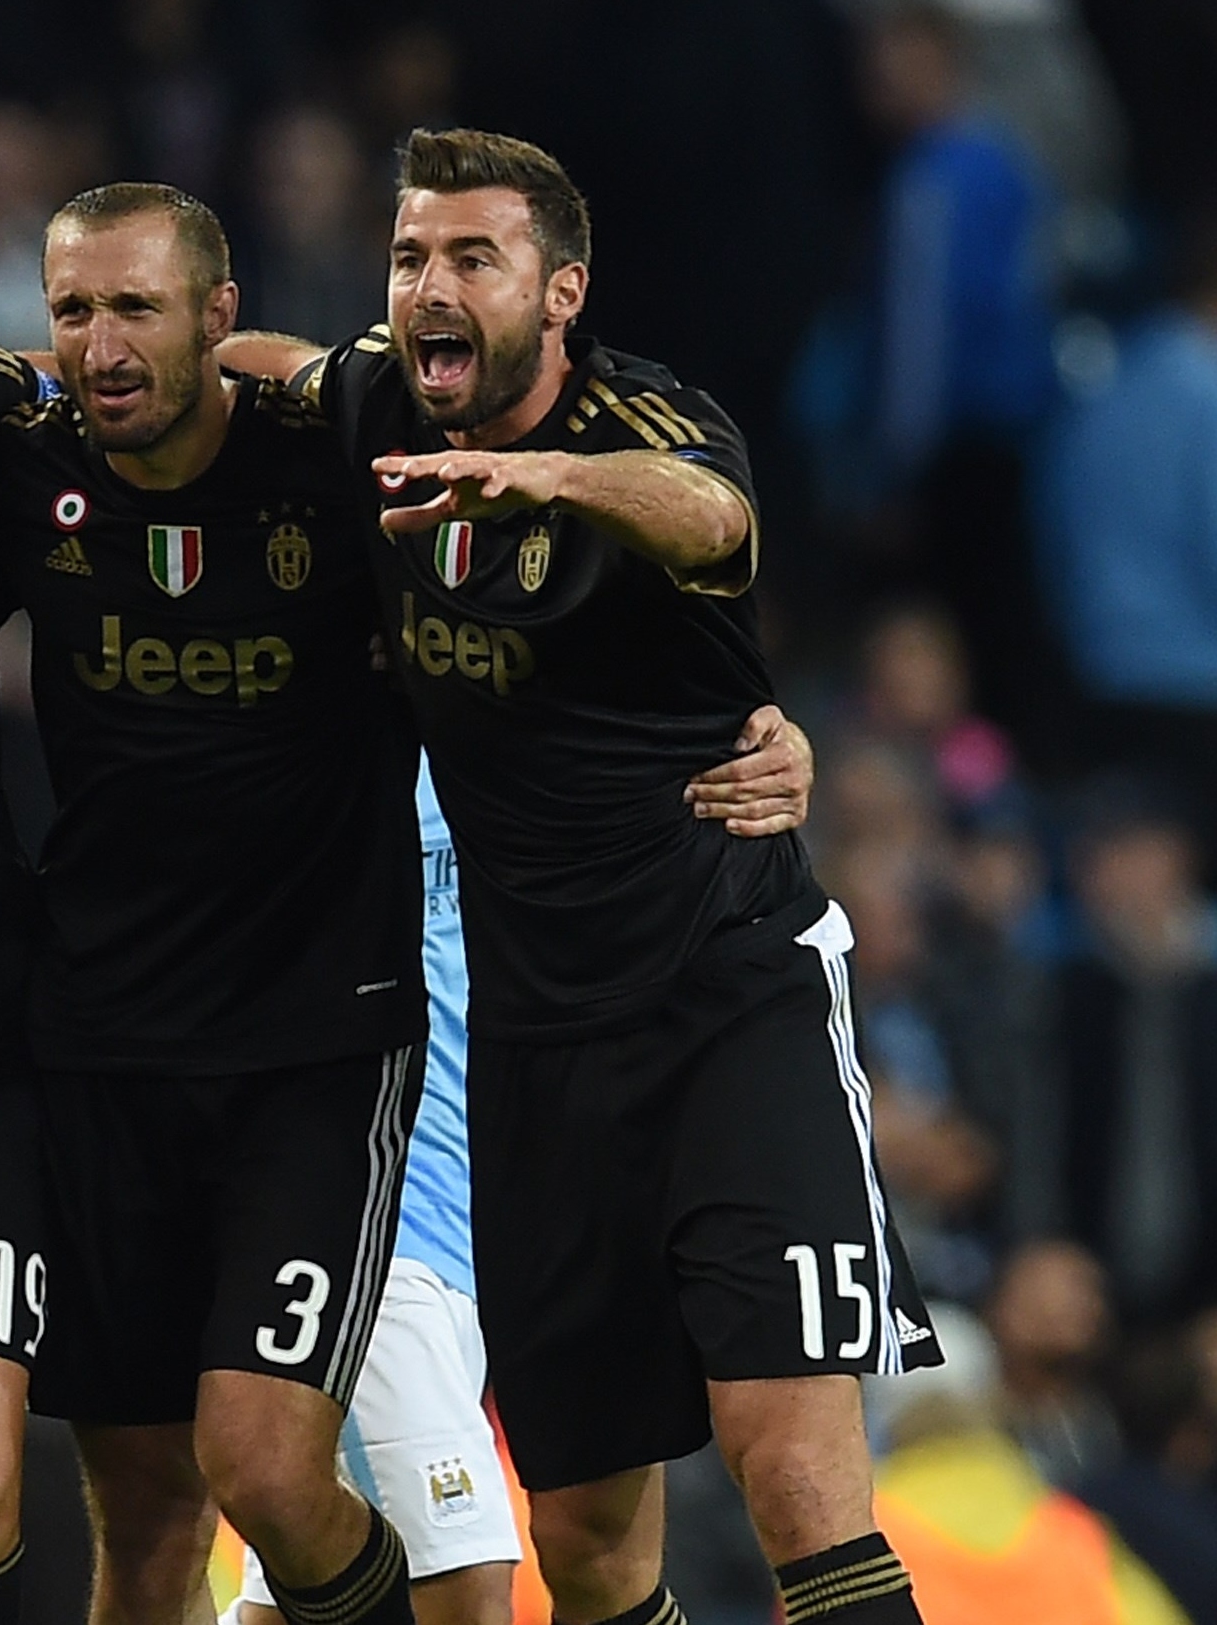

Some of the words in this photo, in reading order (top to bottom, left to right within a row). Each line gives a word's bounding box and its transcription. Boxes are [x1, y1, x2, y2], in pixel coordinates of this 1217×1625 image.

[74, 616, 294, 708] Jeep
[255, 1259, 330, 1365] 3
[784, 1243, 873, 1359] 15
